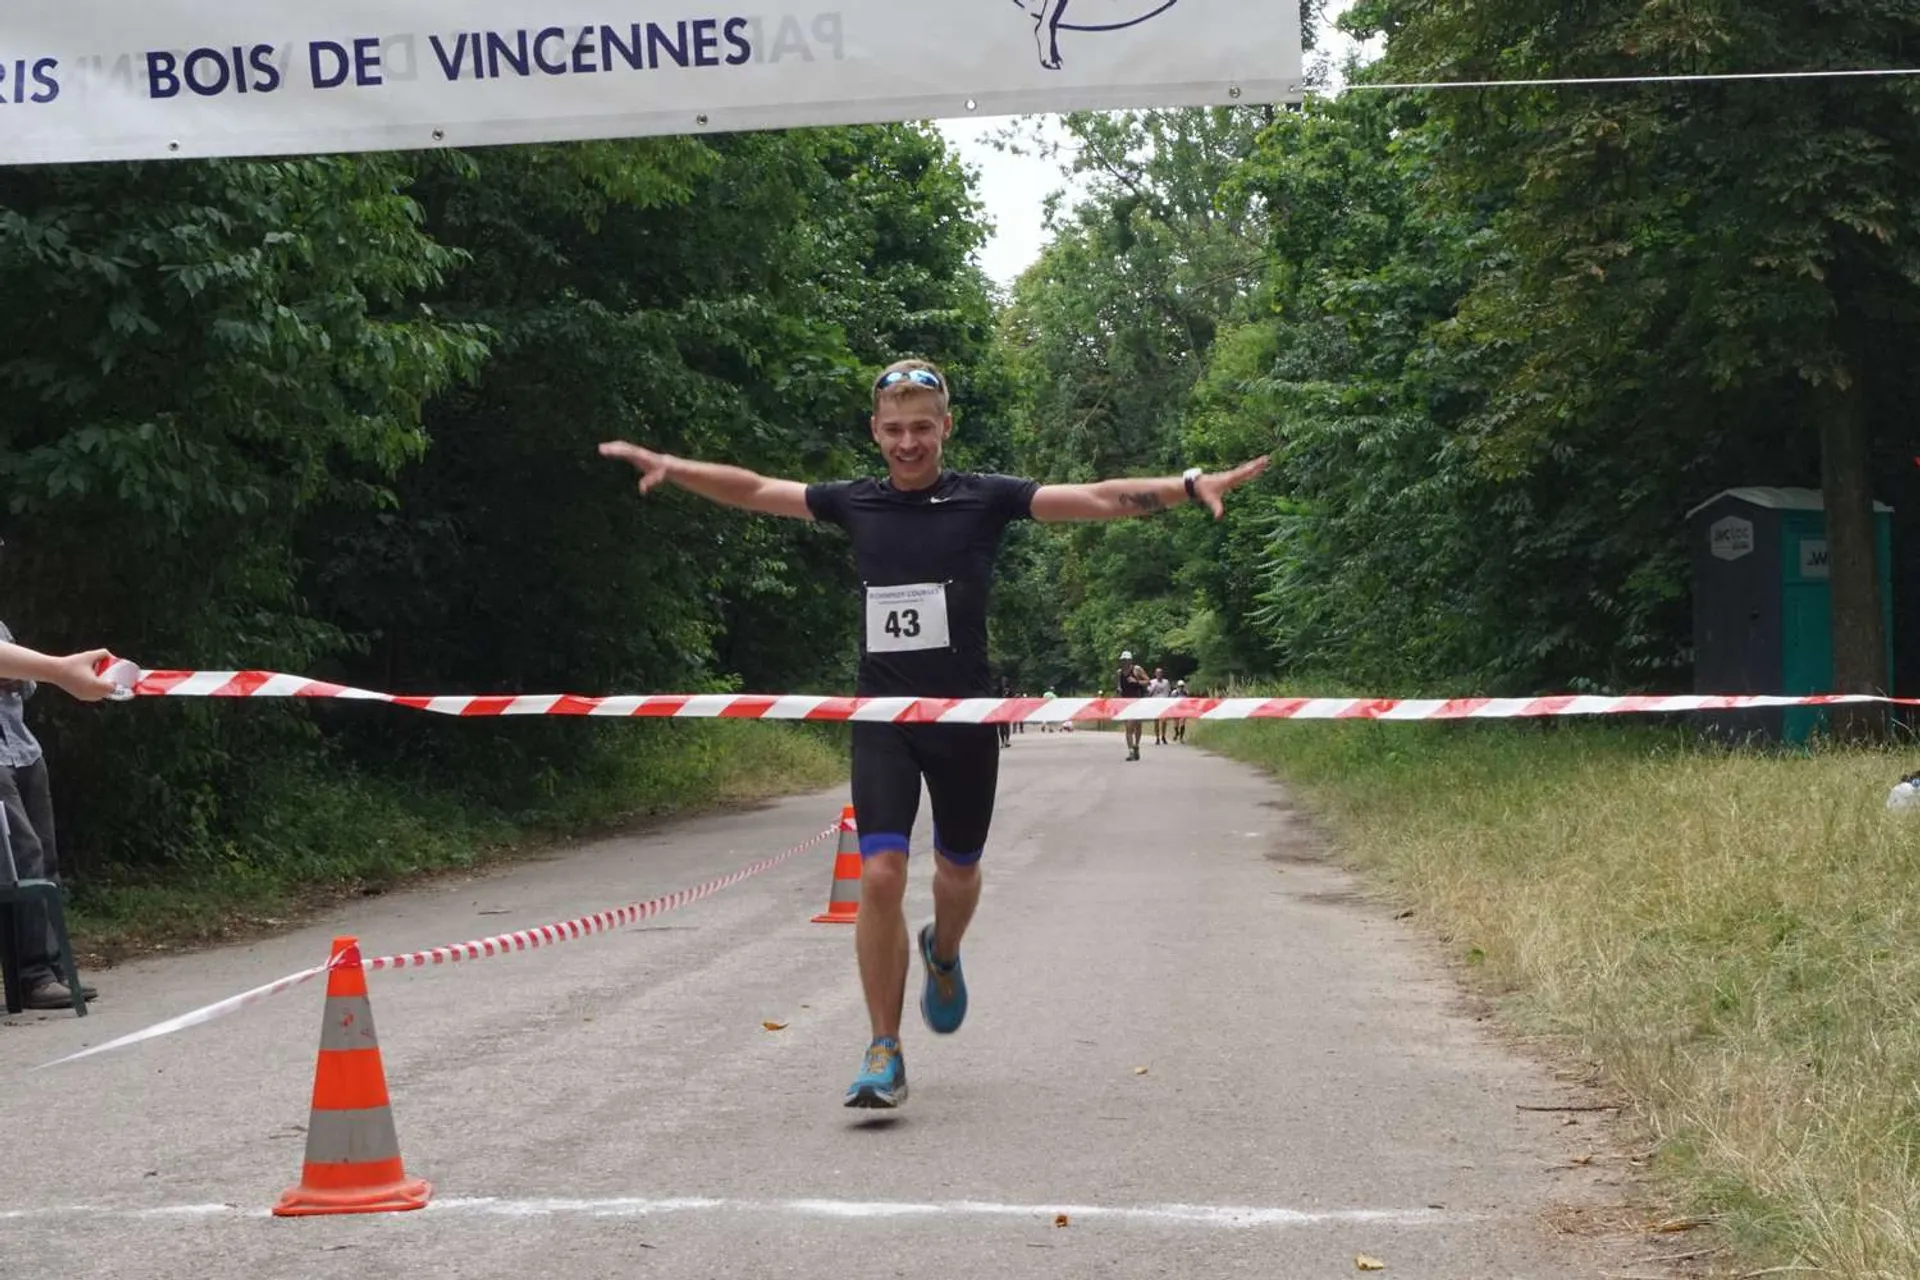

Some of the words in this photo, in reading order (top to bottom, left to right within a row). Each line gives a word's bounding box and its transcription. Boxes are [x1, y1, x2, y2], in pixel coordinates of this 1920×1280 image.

[147, 43, 281, 99] BOIS
[309, 37, 383, 89] DE
[429, 16, 752, 82] VINCENNES
[884, 608, 921, 638] 43
